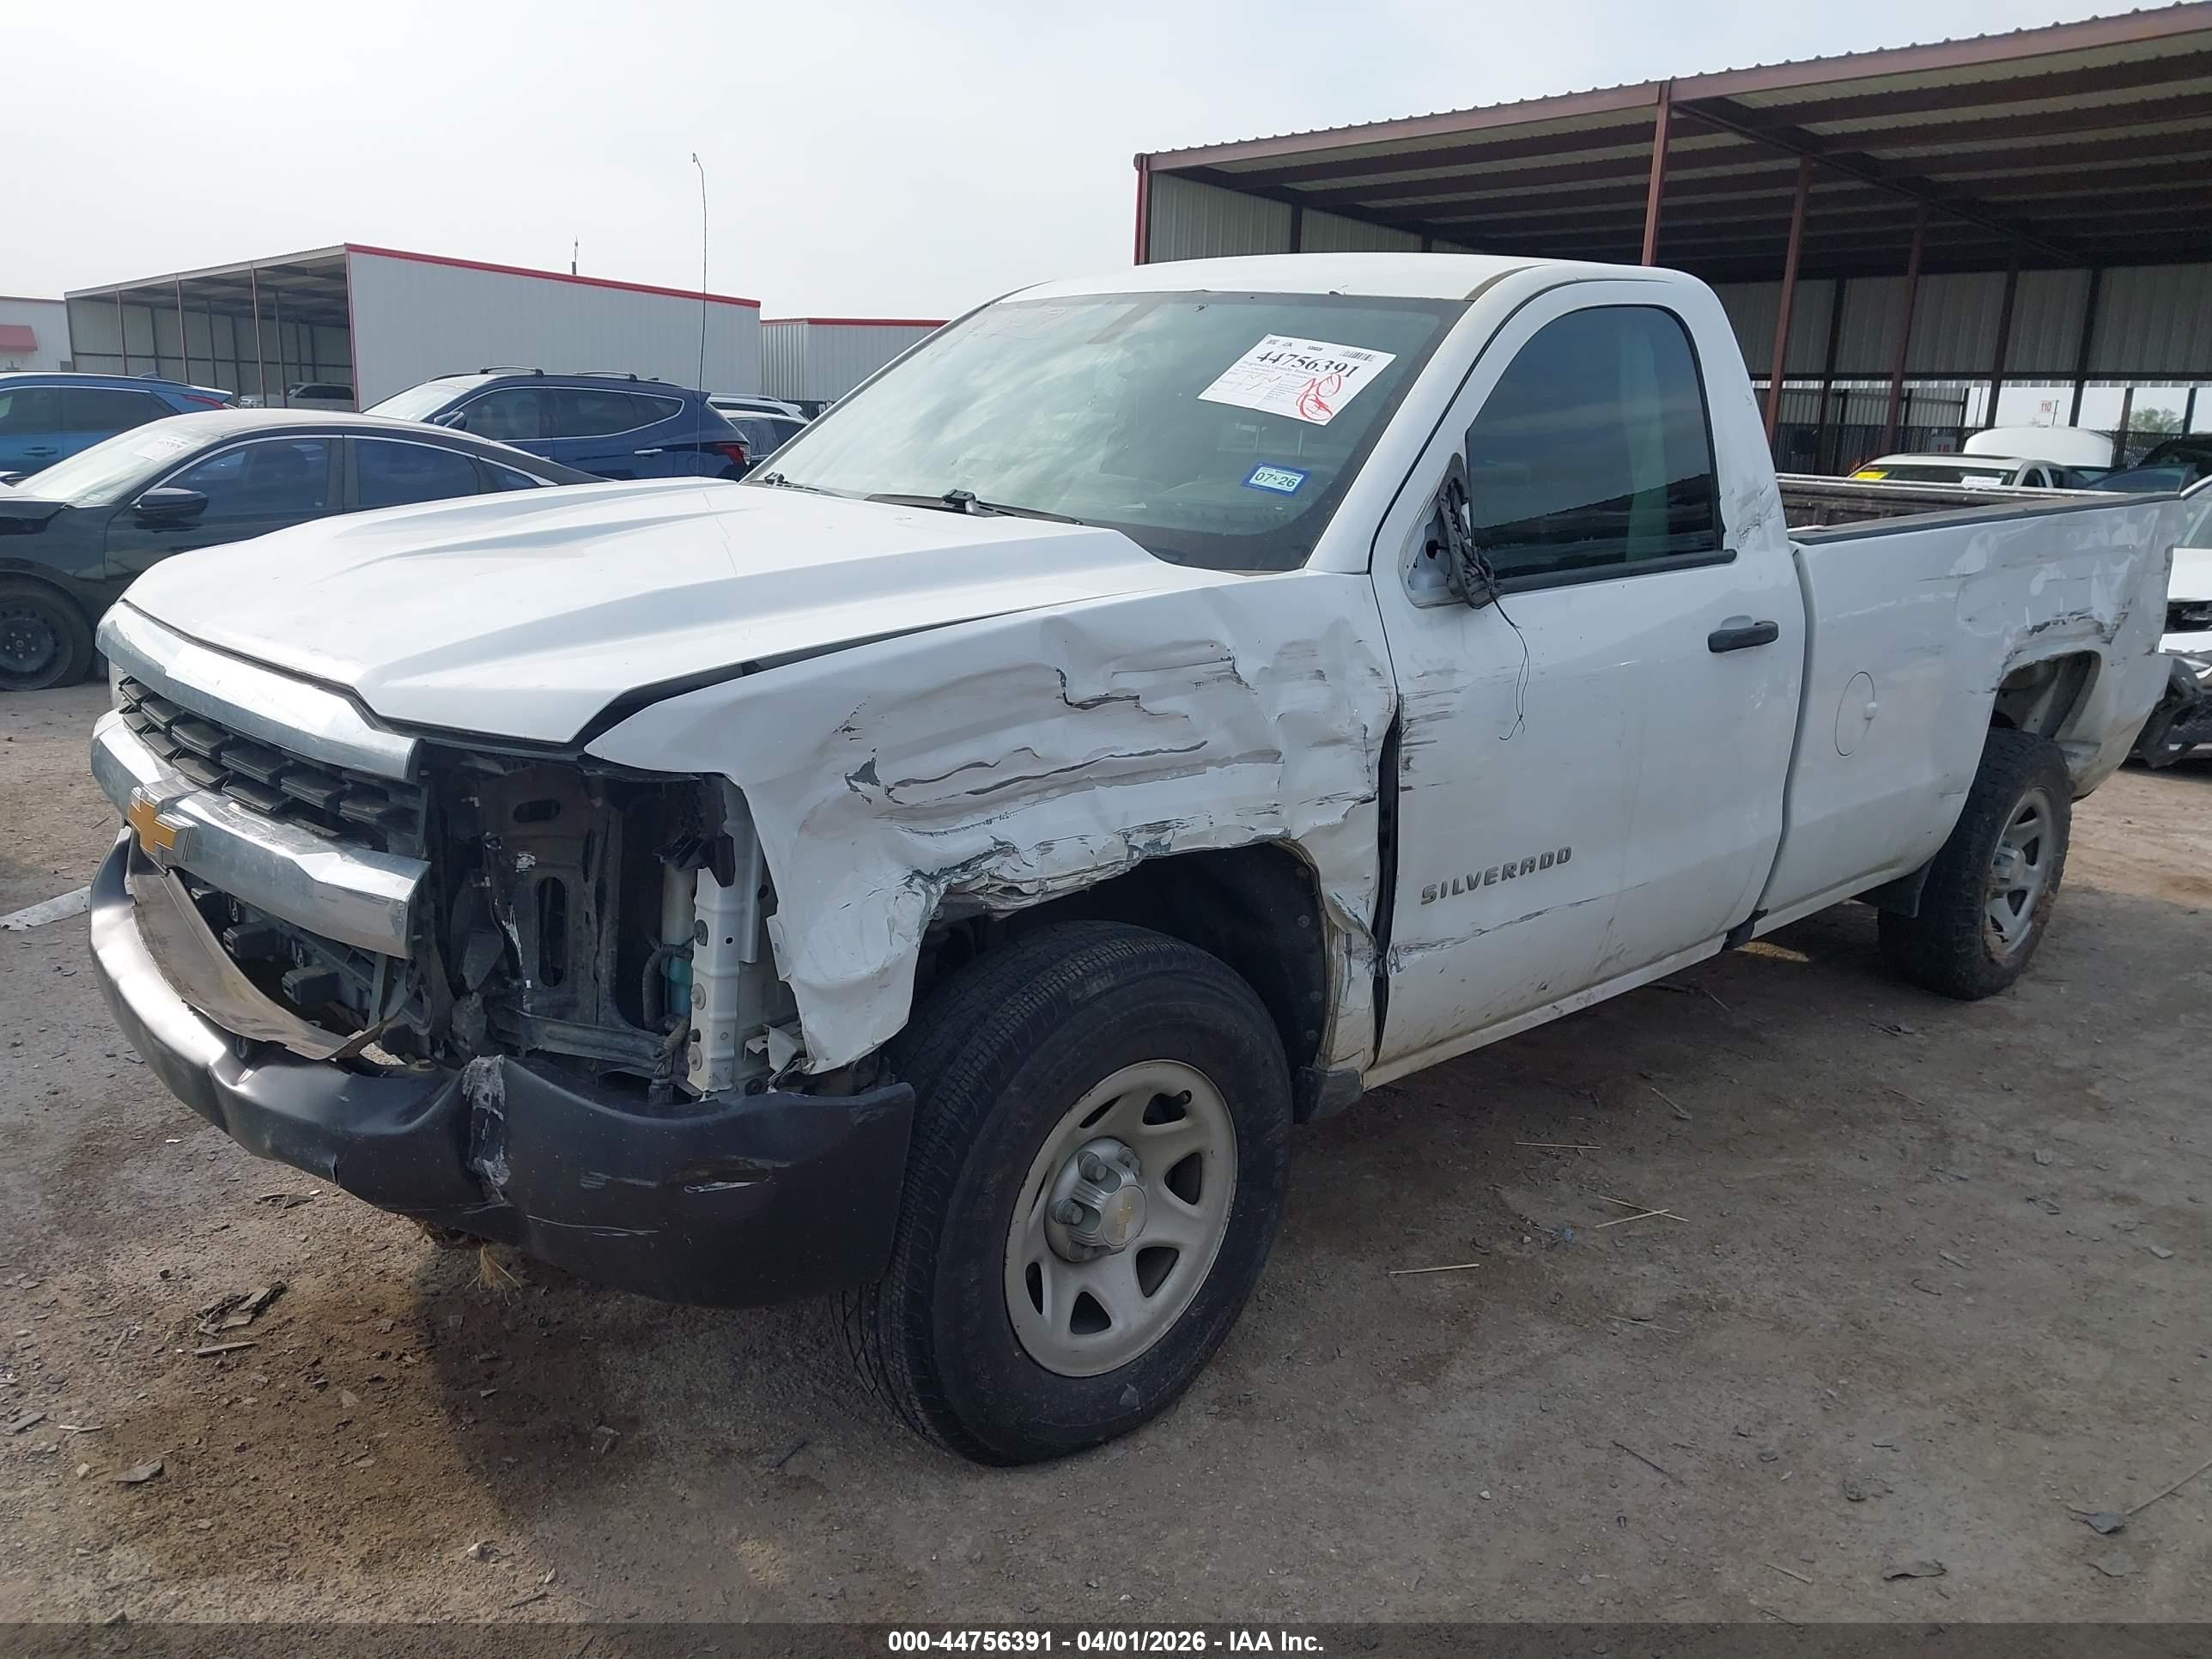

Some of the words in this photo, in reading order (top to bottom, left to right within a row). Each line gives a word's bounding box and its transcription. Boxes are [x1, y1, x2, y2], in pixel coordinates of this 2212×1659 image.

[1256, 351, 1360, 378] 44756391
[1255, 472, 1274, 482] 07
[1277, 476, 1297, 487] 26
[1420, 846, 1573, 905] SILVERADO
